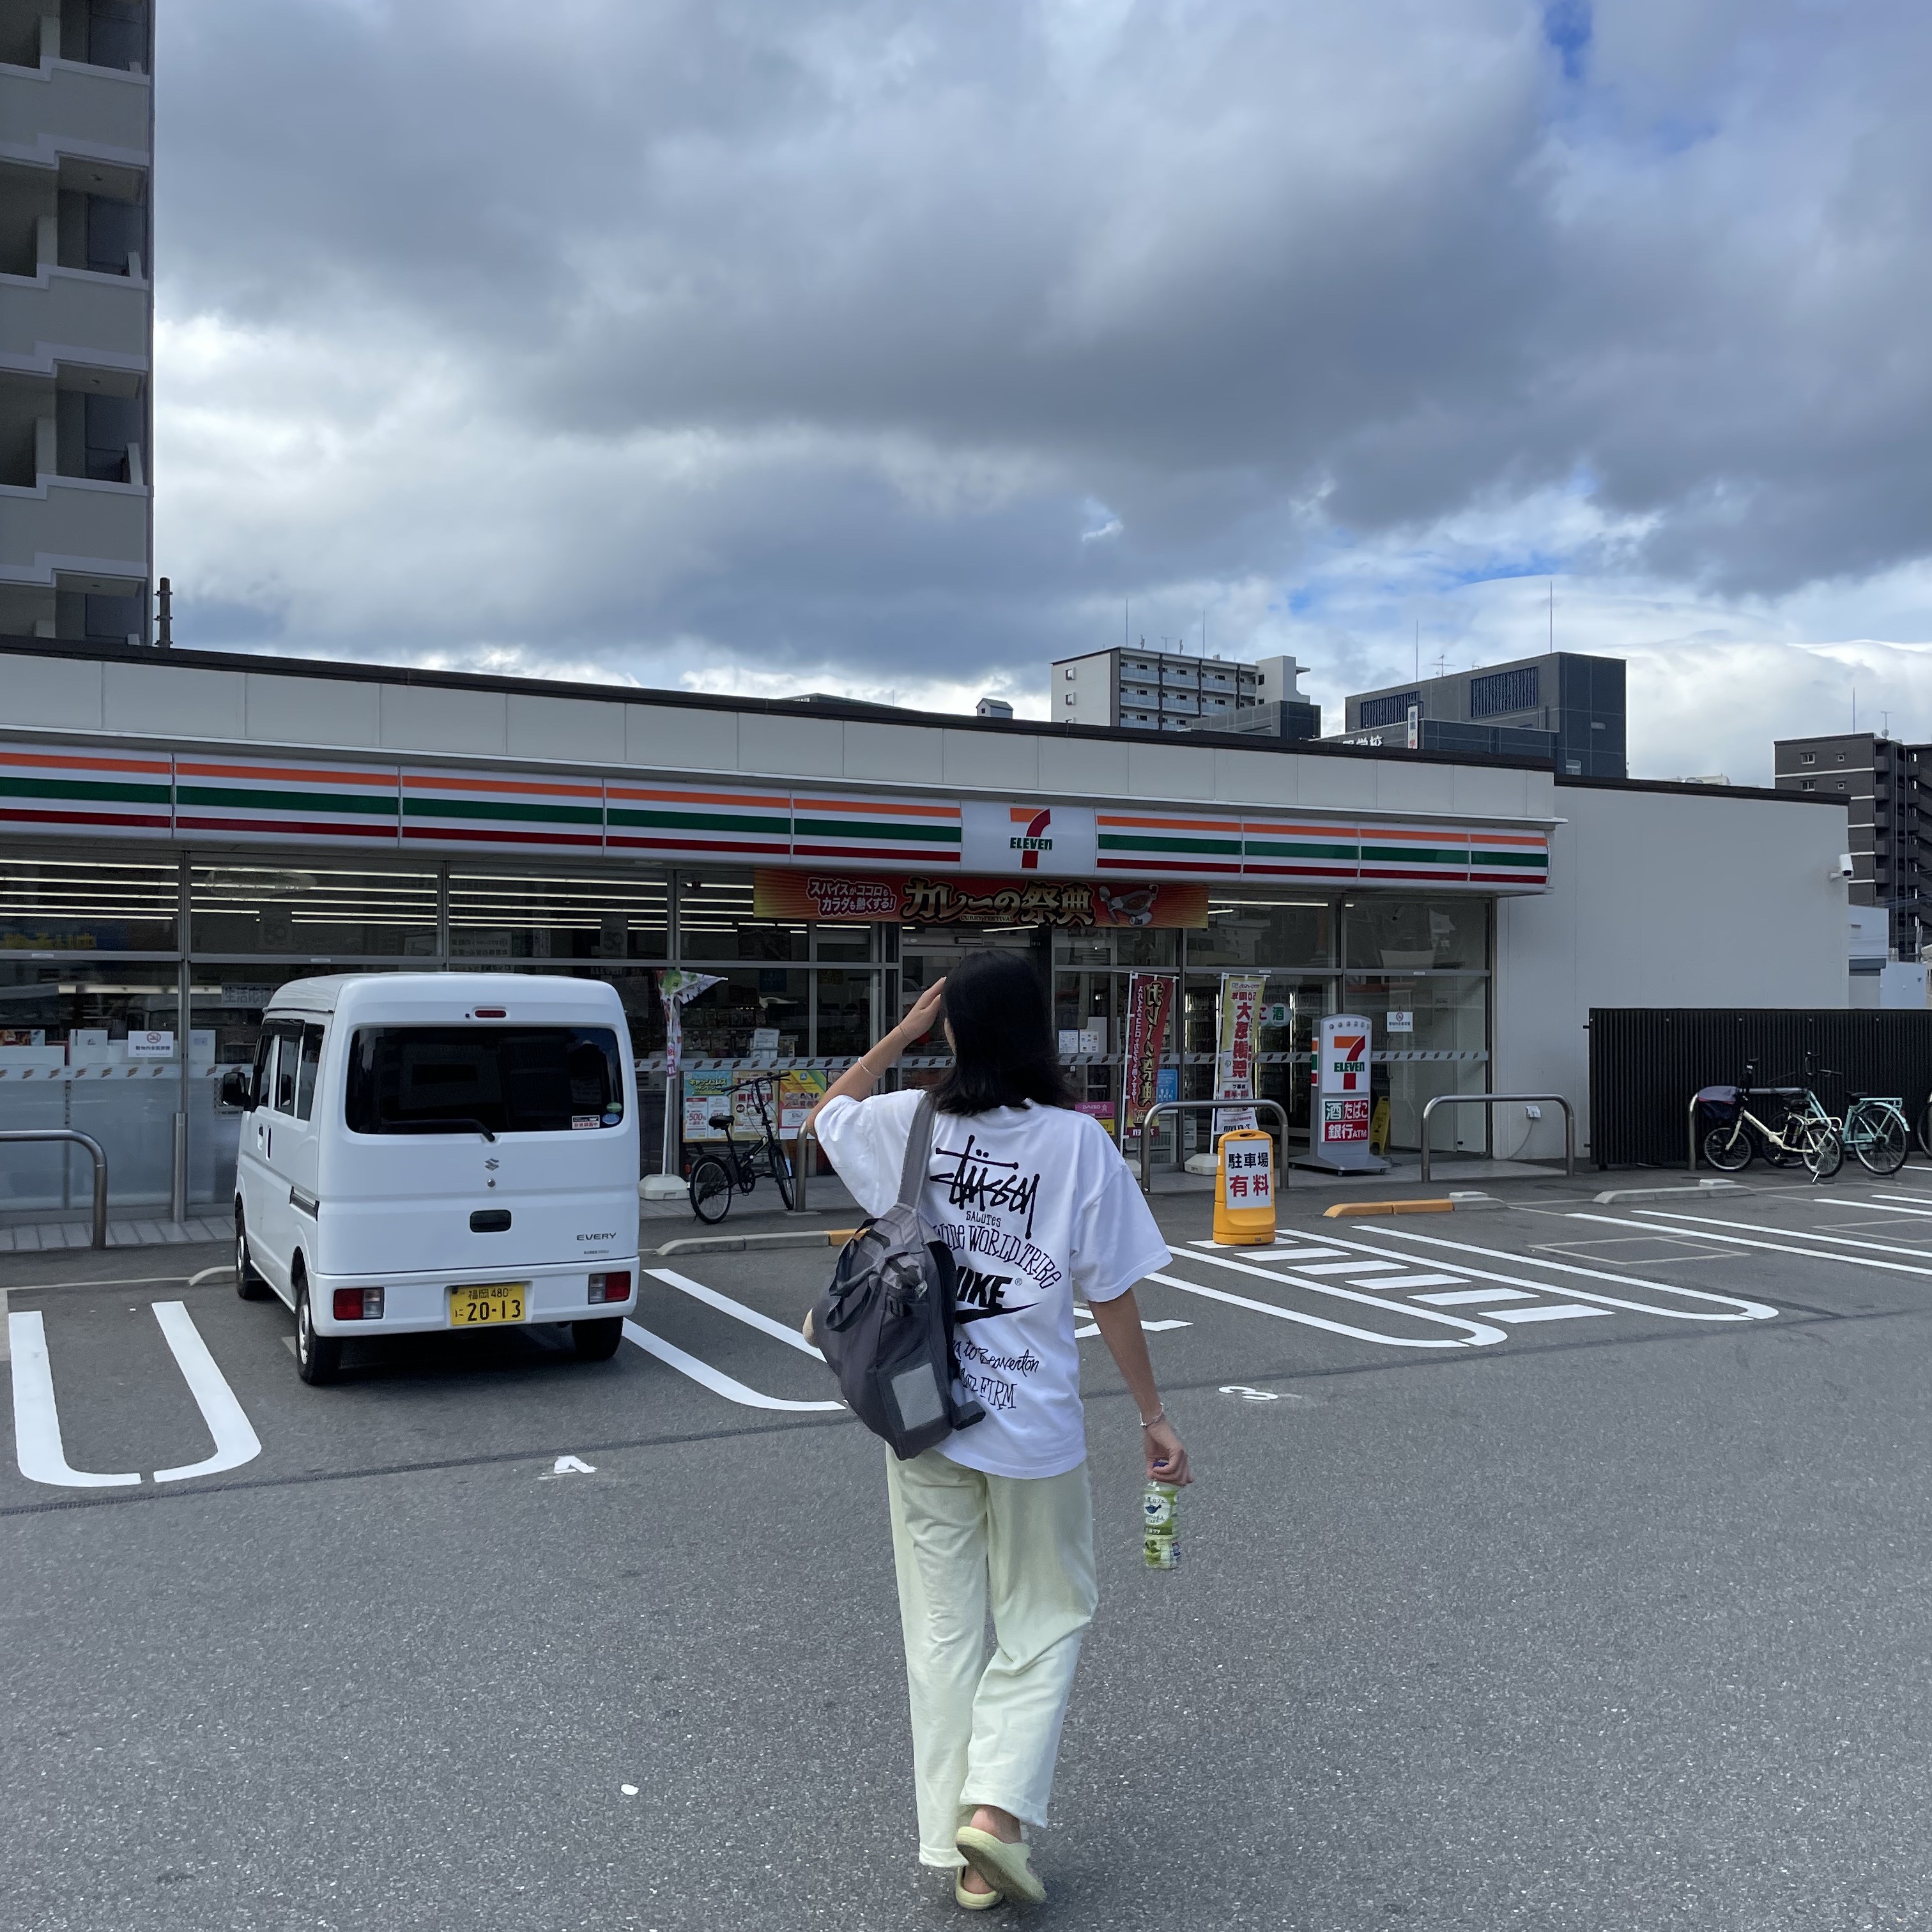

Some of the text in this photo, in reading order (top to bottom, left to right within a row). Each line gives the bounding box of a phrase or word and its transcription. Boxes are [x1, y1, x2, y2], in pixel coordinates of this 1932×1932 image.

[810, 882, 889, 896] スパイスがココロも
[822, 896, 894, 912] カラダも熱くする!
[901, 879, 1094, 926] カレーの祭典
[1326, 1101, 1368, 1120] 酒 たばこ
[1228, 1152, 1269, 1169] 駐車場
[1229, 1173, 1269, 1198] 有料
[576, 1232, 617, 1241] EVERY
[969, 1225, 1022, 1263] WORLD
[491, 1287, 509, 1298] 480
[467, 1300, 521, 1321] 20-13
